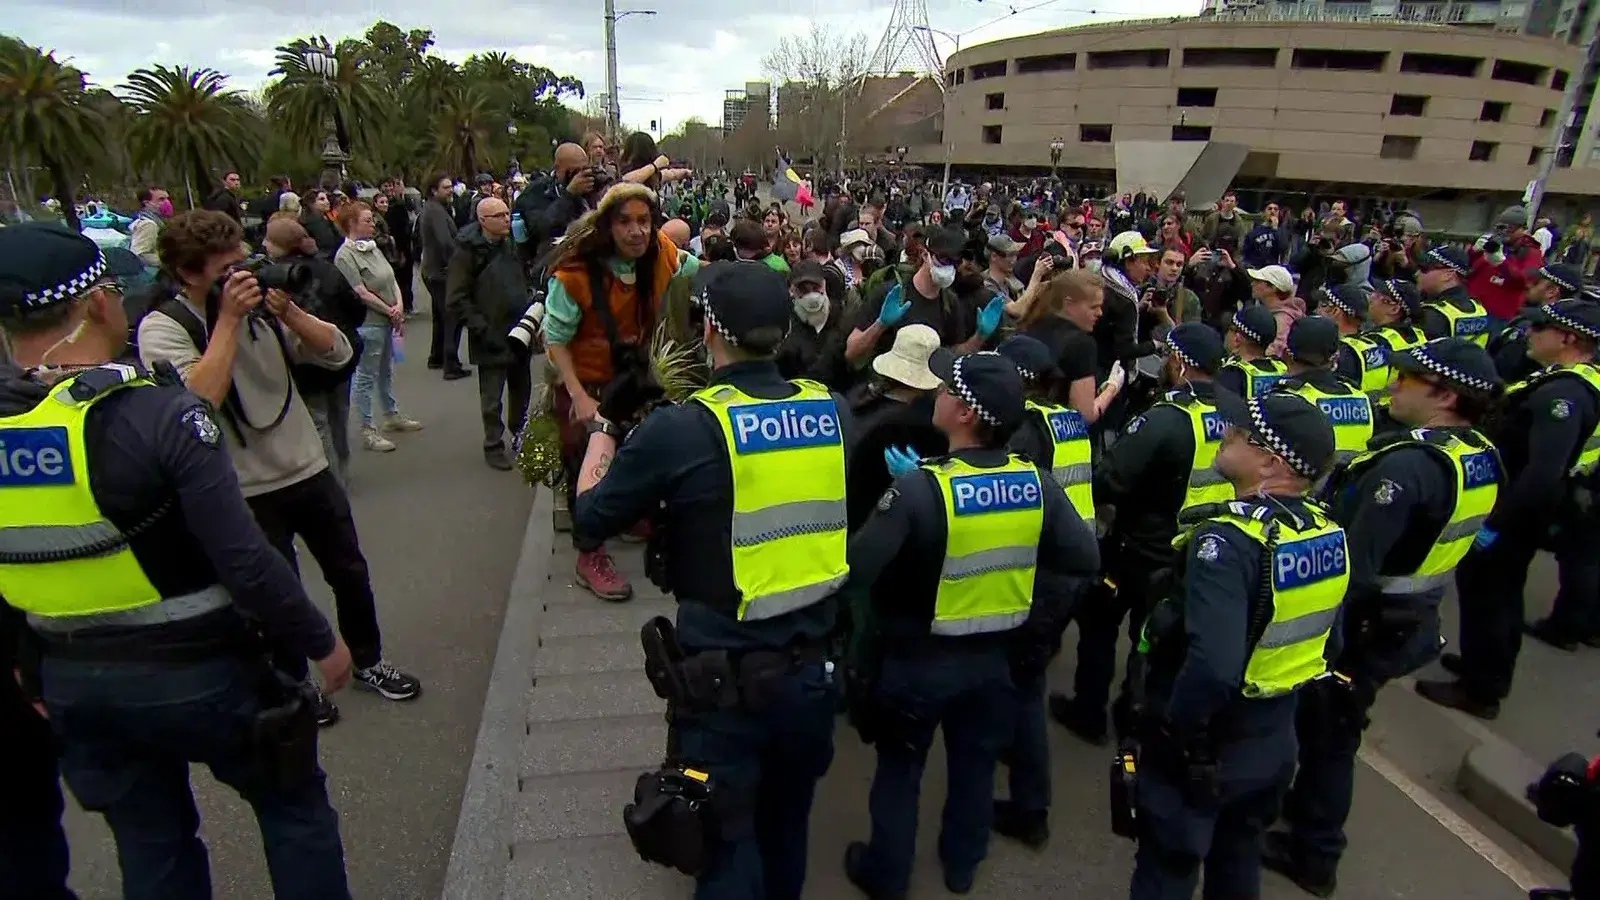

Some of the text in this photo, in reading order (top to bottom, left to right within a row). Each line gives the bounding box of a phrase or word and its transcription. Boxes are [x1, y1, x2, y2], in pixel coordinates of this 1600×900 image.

[736, 408, 836, 444] Police
[1320, 402, 1368, 420] Police
[955, 479, 1038, 508] Police
[1277, 546, 1344, 582] Police
